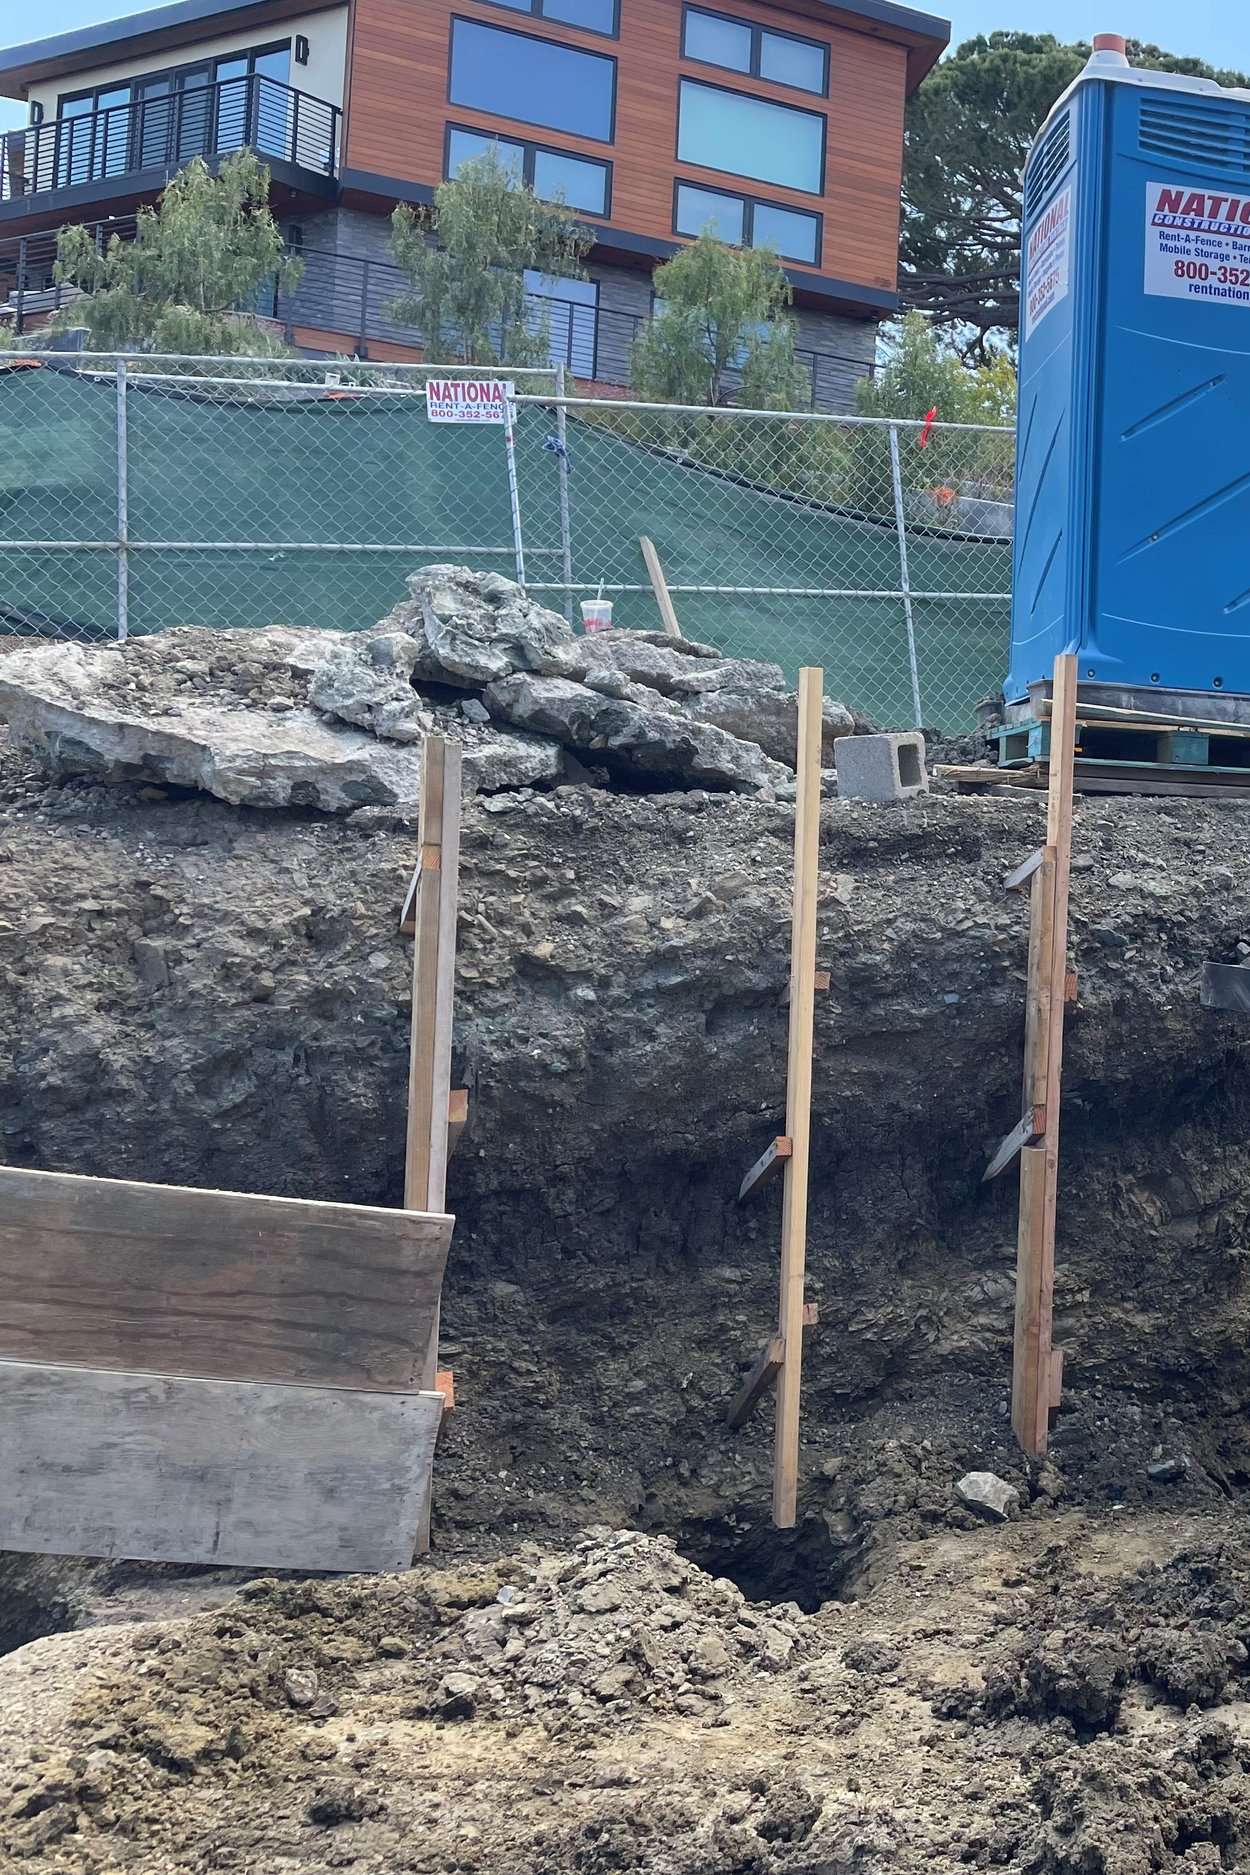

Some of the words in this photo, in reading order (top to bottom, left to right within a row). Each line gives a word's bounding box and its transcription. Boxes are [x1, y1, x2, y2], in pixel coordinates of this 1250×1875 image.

[1159, 230, 1223, 248] Rent-A-Fence
[1159, 242, 1192, 256] Mobile
[1194, 247, 1231, 262] Storage
